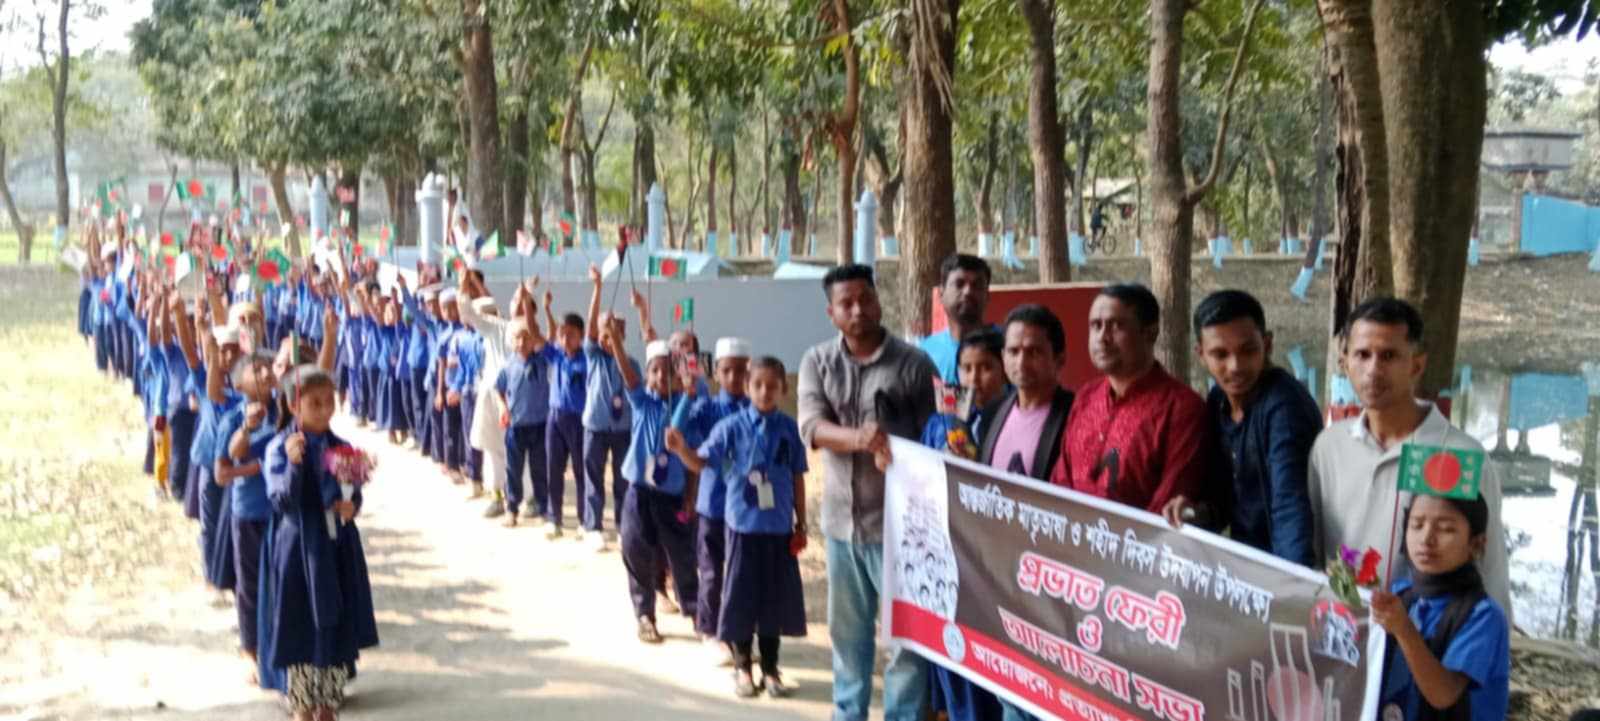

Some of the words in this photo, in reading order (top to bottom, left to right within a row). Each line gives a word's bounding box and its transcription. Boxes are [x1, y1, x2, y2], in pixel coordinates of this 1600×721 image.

[958, 482, 1016, 525] আন্তর্জাতিক
[1018, 502, 1067, 546] মাতৃভাষা
[1071, 522, 1082, 546] ও
[1086, 517, 1121, 565] শহীদ
[1122, 528, 1157, 575] দিবস
[1017, 551, 1105, 611] প্রভাত
[1104, 585, 1187, 649] ফেরী
[1076, 614, 1103, 653] ও
[997, 604, 1131, 703] আলোচনা
[1131, 672, 1205, 721] সভা
